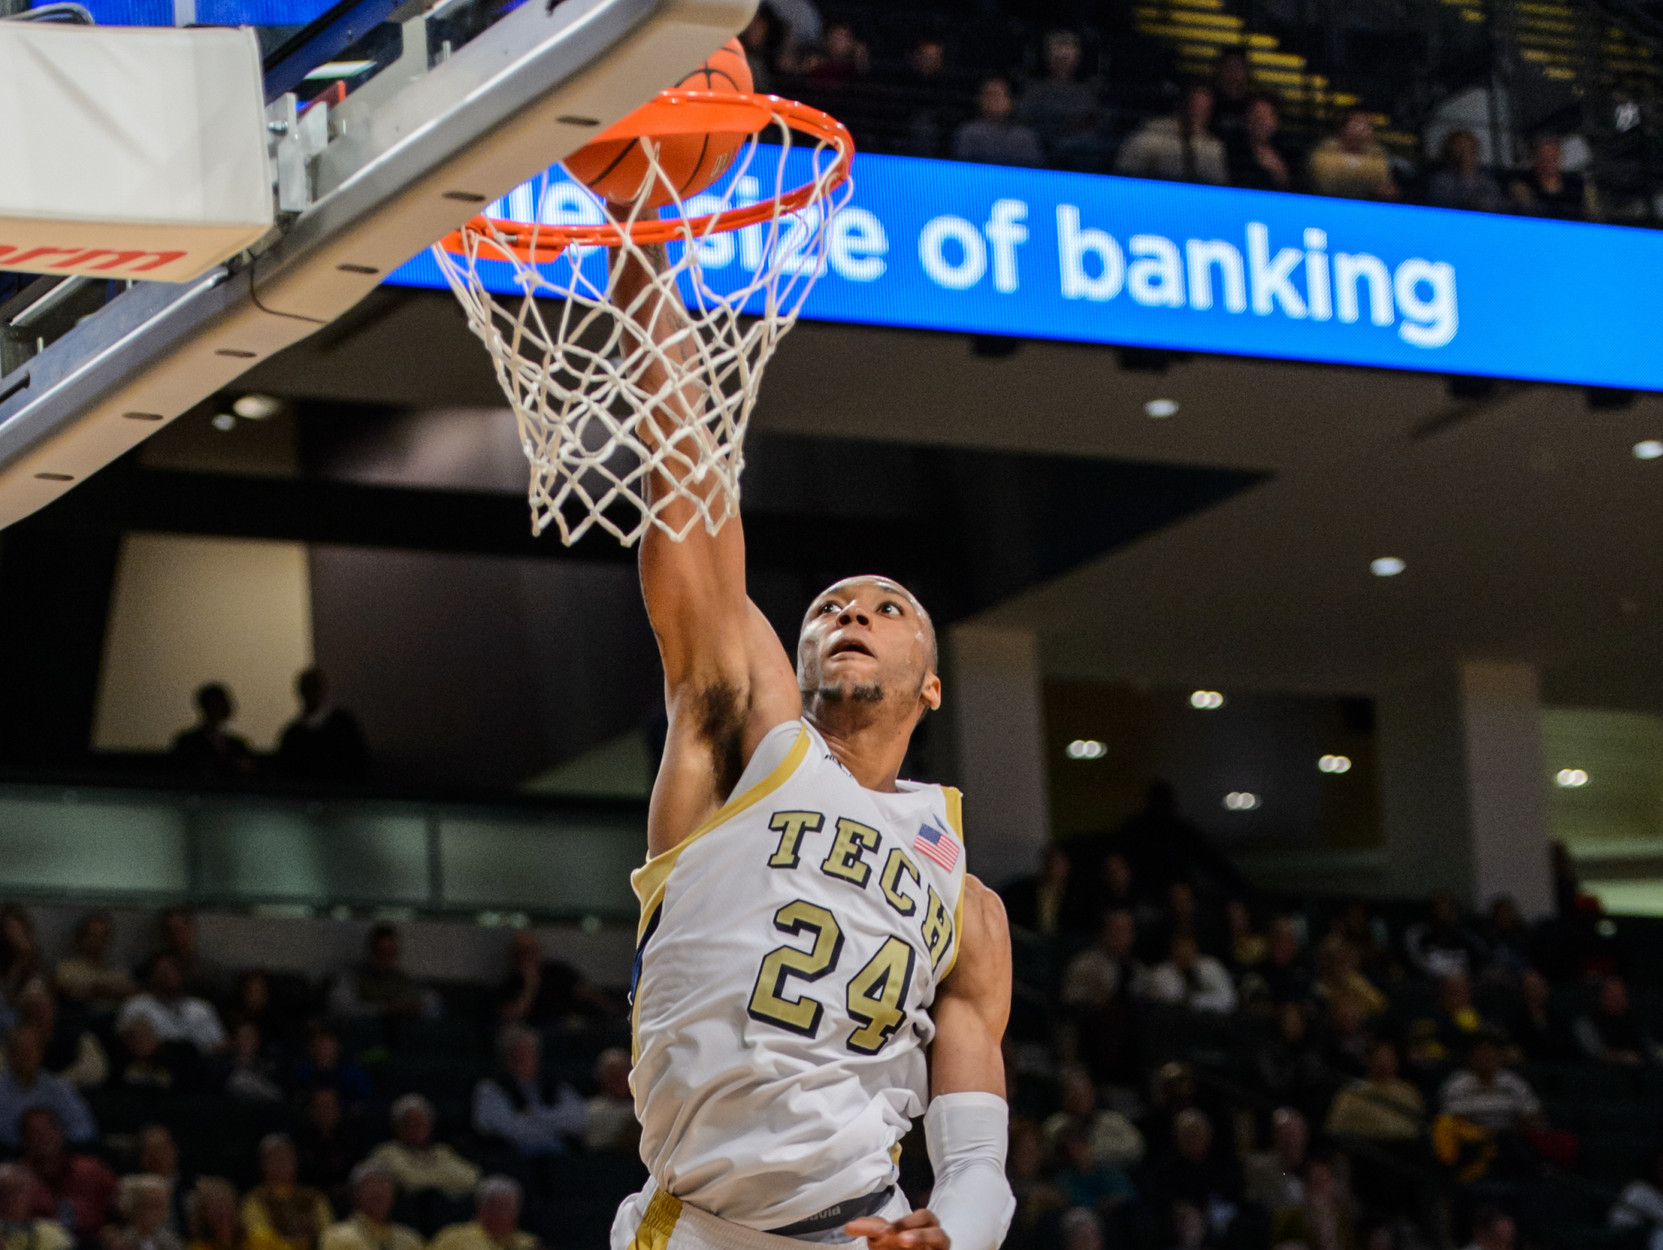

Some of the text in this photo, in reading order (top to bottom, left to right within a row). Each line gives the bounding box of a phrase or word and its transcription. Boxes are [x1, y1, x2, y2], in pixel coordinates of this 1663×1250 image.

[681, 175, 889, 282] size
[920, 200, 1030, 293] of
[1055, 204, 1459, 348] banking
[767, 810, 955, 970] TECH
[747, 898, 916, 1055] 24
